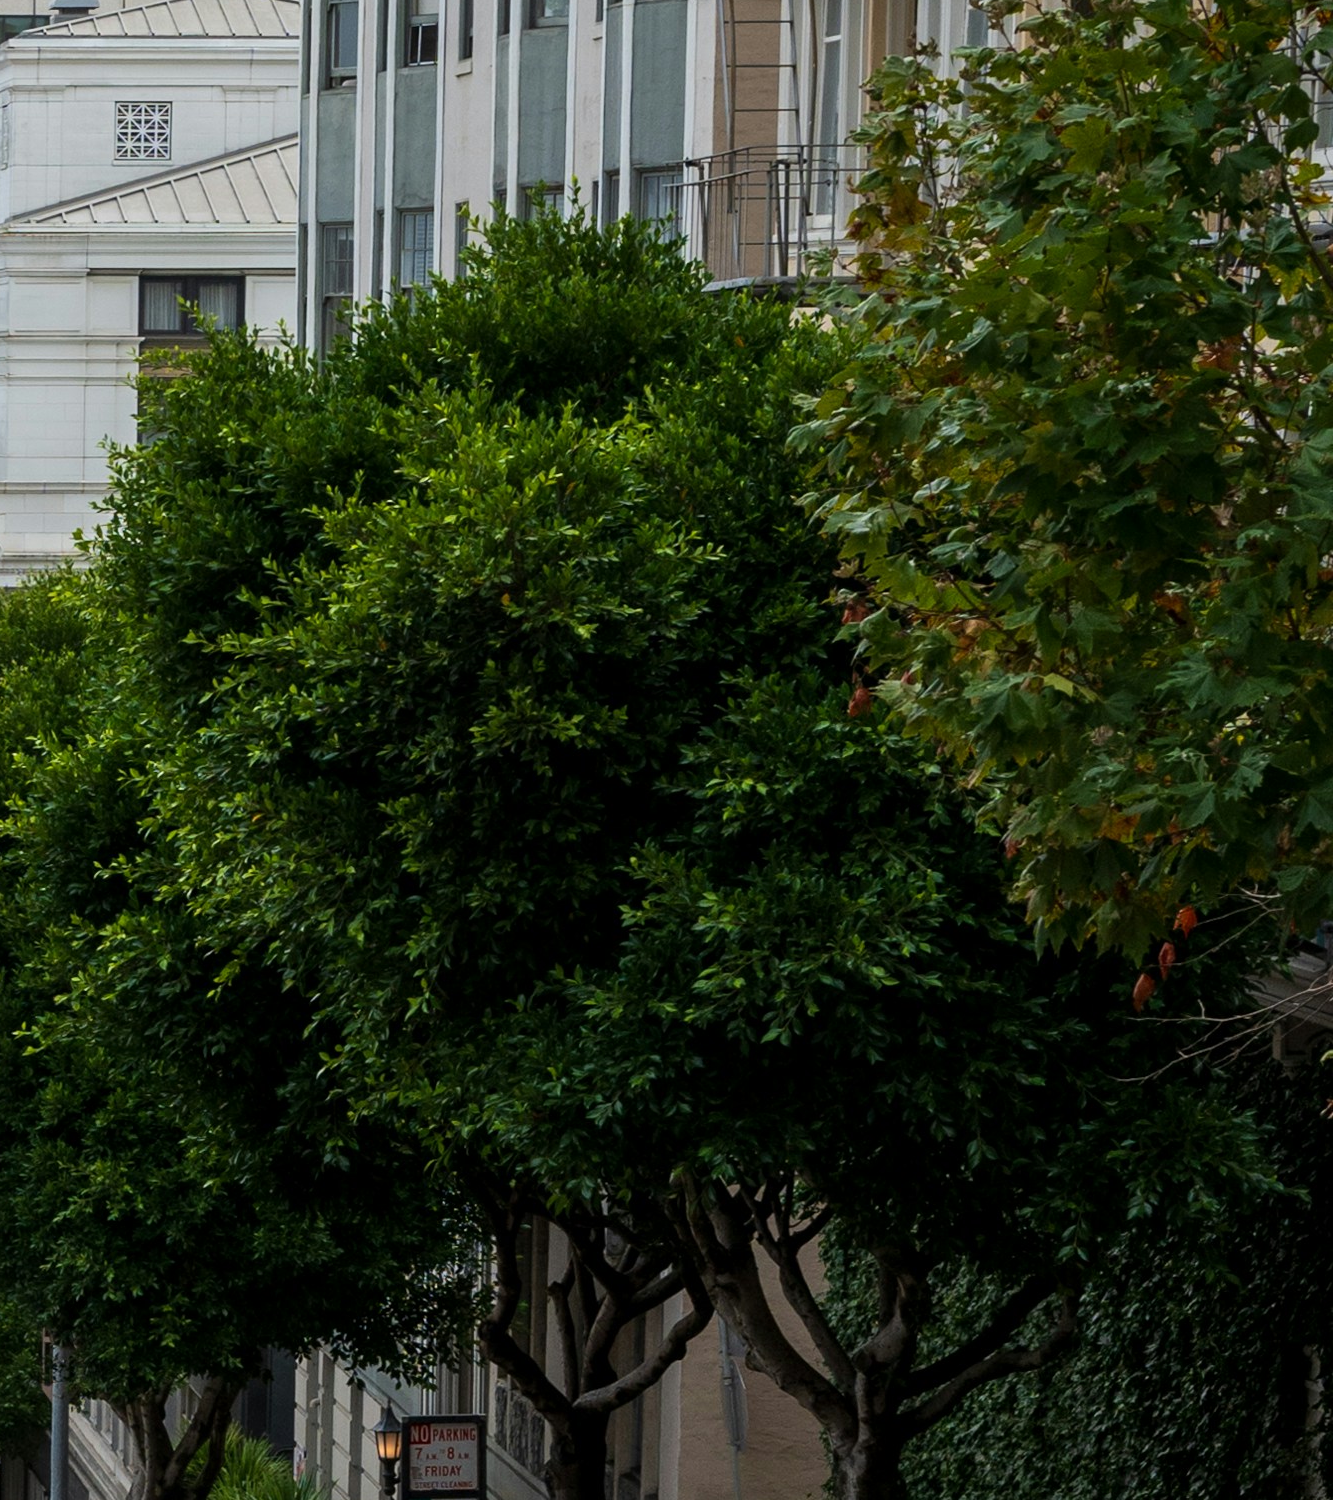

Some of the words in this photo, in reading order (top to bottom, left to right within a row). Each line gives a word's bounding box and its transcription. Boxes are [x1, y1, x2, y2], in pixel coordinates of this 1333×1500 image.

[410, 1425, 429, 1443] NO
[433, 1428, 476, 1442] PARKING
[414, 1447, 423, 1460] 7
[447, 1447, 455, 1460] 8
[424, 1465, 462, 1477] FRIDAY
[414, 1481, 439, 1489] STREET
